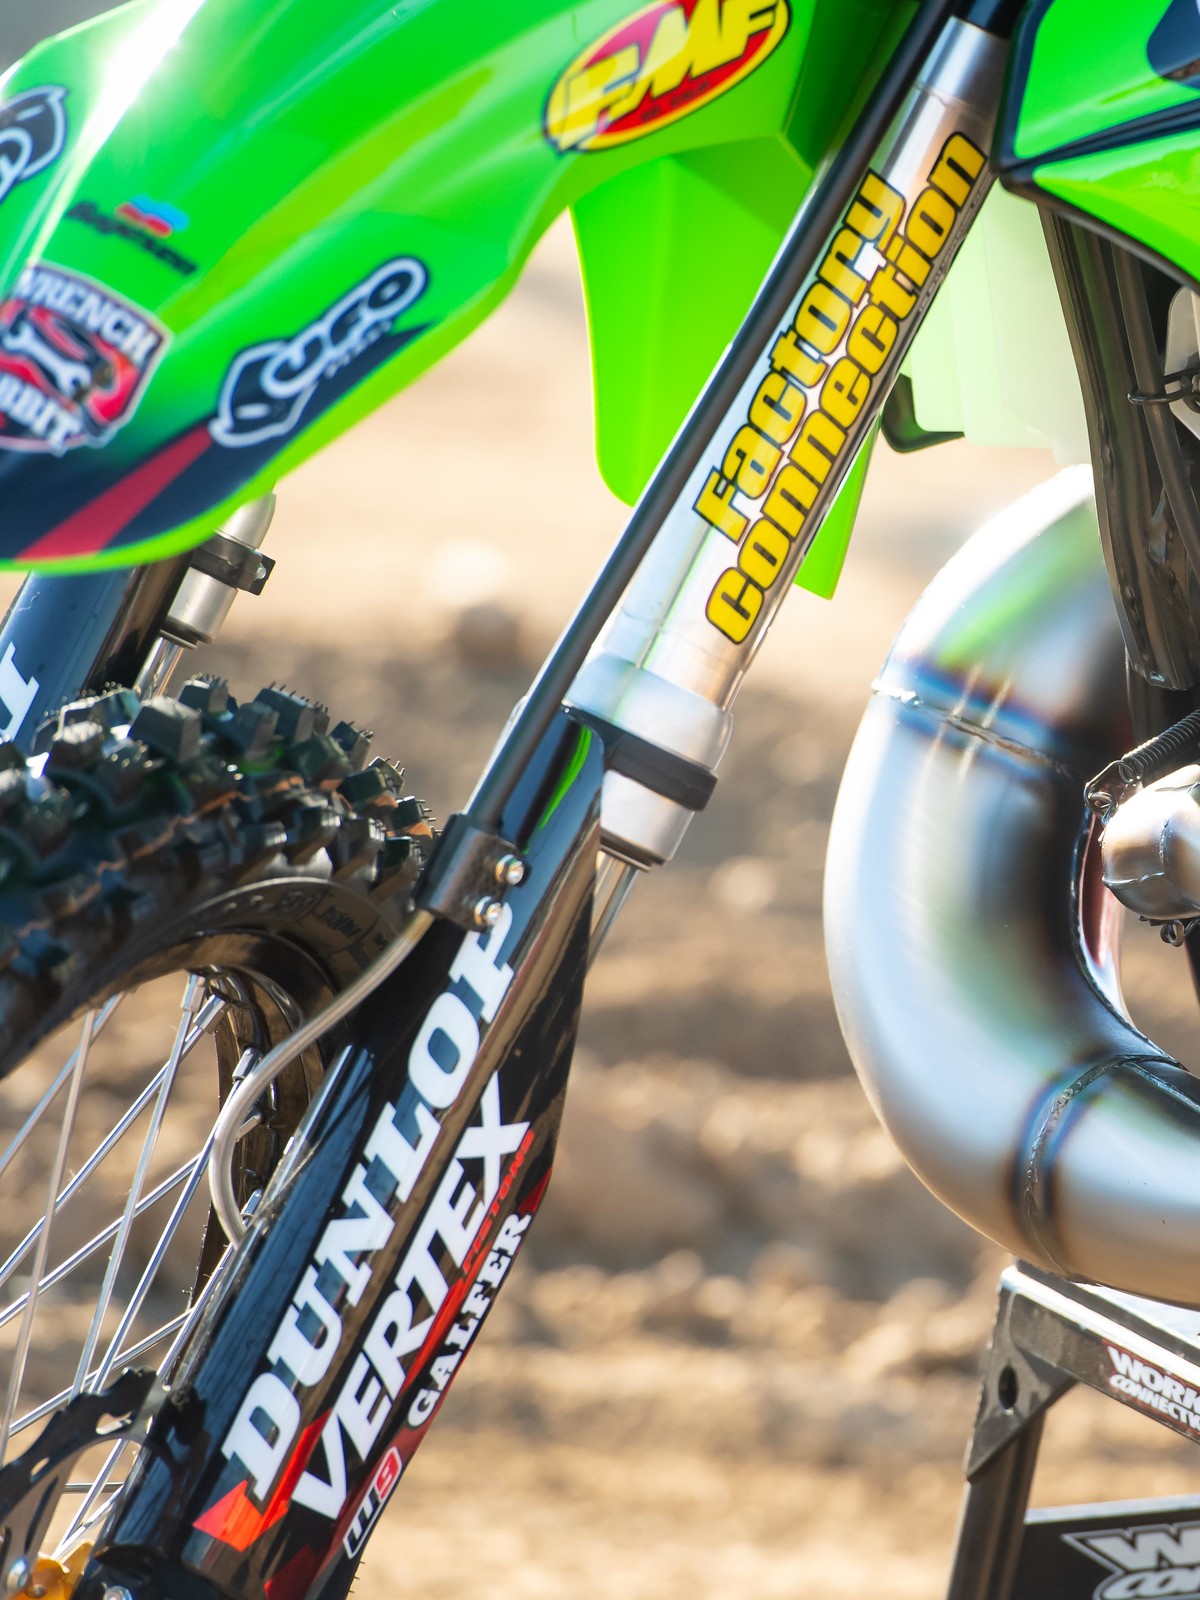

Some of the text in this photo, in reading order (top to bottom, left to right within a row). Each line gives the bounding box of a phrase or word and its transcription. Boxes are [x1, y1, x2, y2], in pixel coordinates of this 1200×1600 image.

[220, 902, 514, 1500] DUNLOP
[291, 1070, 530, 1520] VERTEX
[408, 1213, 532, 1428] GALFER
